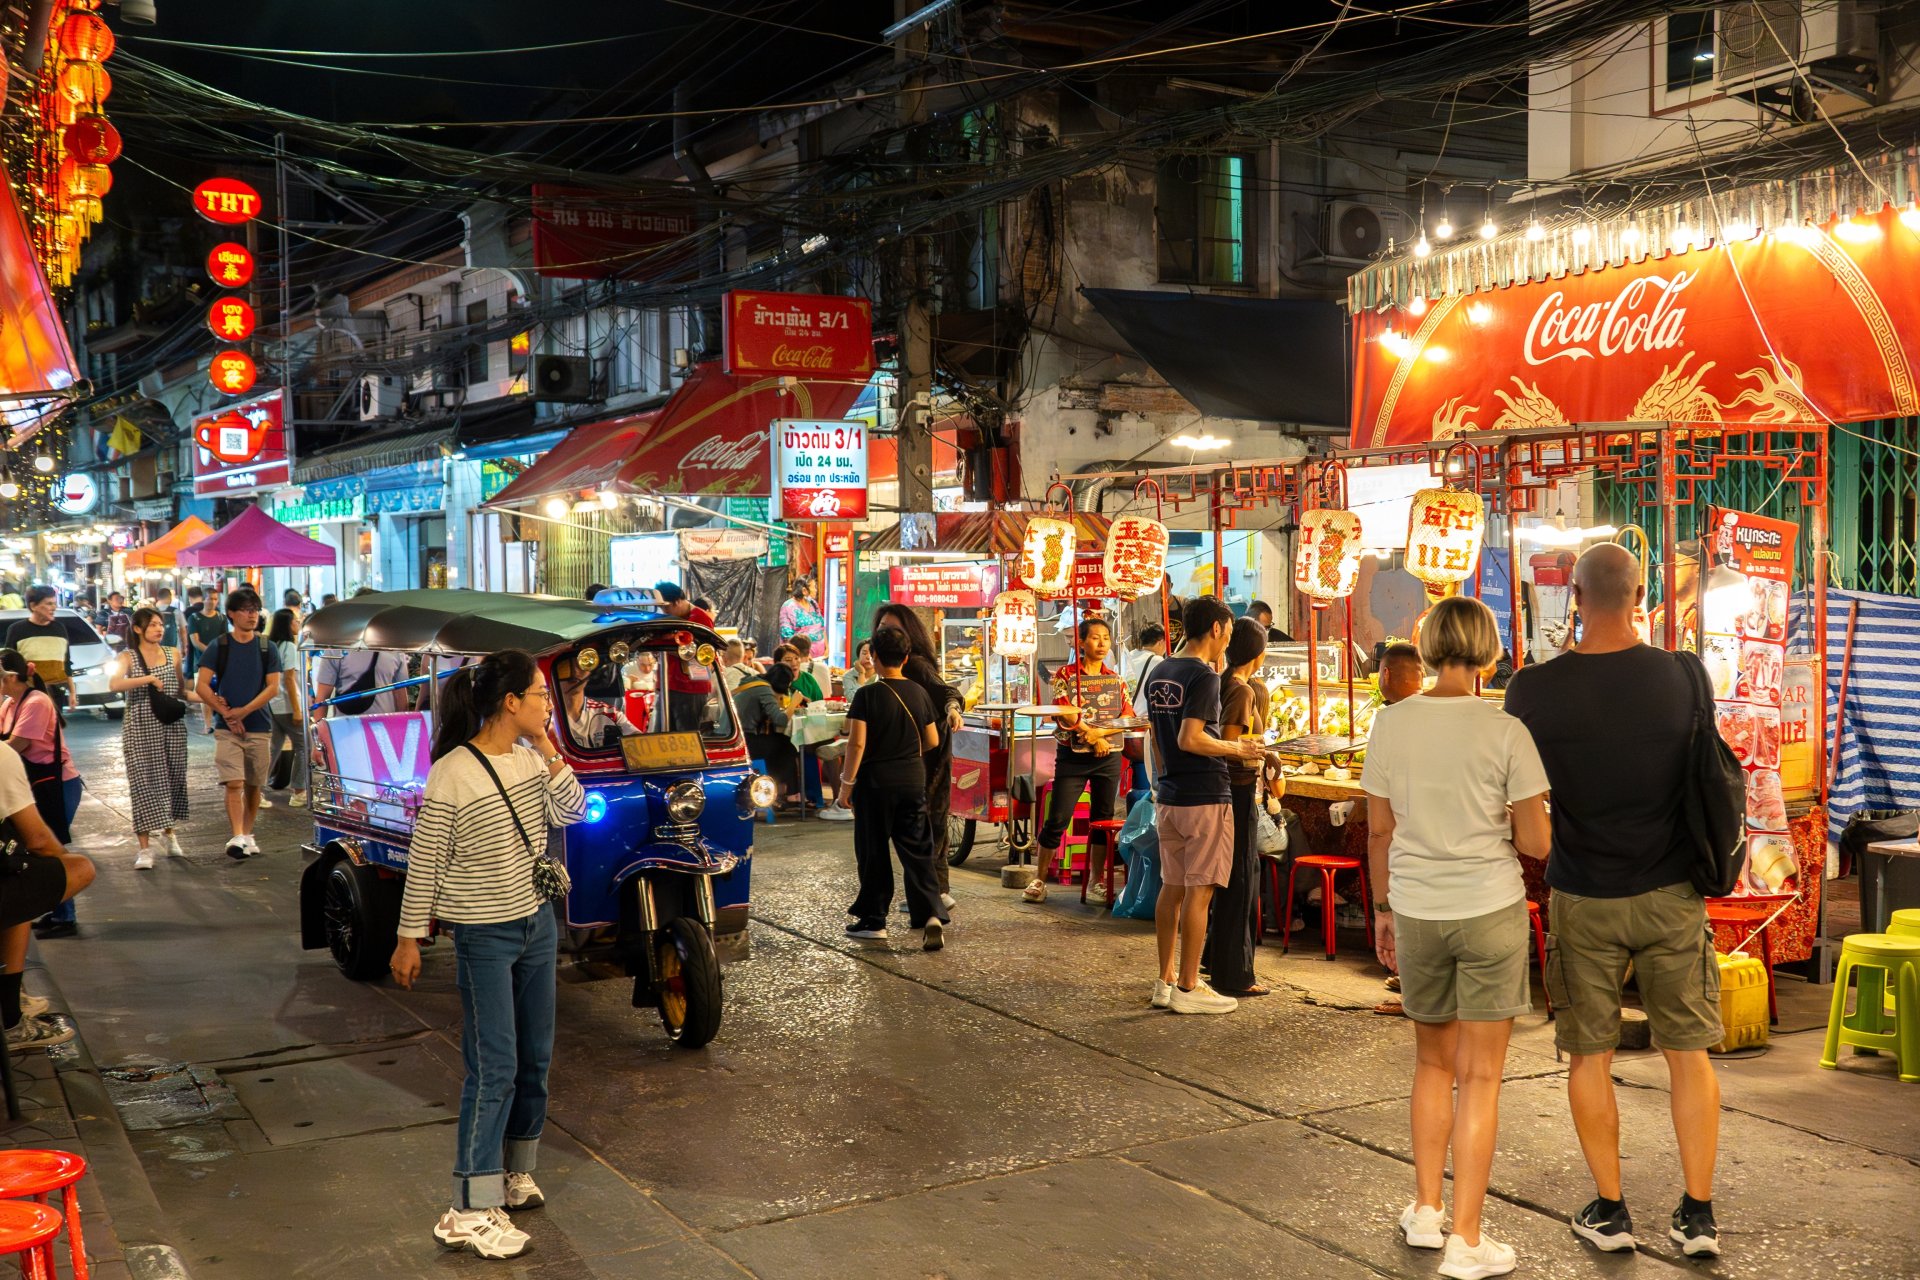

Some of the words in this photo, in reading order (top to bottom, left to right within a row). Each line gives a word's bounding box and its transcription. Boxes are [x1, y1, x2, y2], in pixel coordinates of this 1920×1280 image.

[202, 191, 255, 214] THT
[754, 304, 811, 327] ข้าวต้ม
[819, 311, 849, 329] 3/1
[1524, 267, 1699, 366] Coca-Cola
[799, 329, 809, 337] 24
[772, 344, 835, 368] Coca-Cola
[784, 424, 830, 449] ข้าวต้ม
[835, 427, 862, 449] 3/1
[796, 451, 812, 467] เปิด
[817, 455, 831, 467] 24
[836, 457, 853, 468] ชม.
[788, 471, 811, 483] อร่อย
[815, 474, 826, 486] ถูก
[829, 471, 860, 483] ประหยัด
[1736, 526, 1781, 550] หมูกระทะ
[616, 589, 657, 601] TAXI
[1783, 686, 1807, 703] AR
